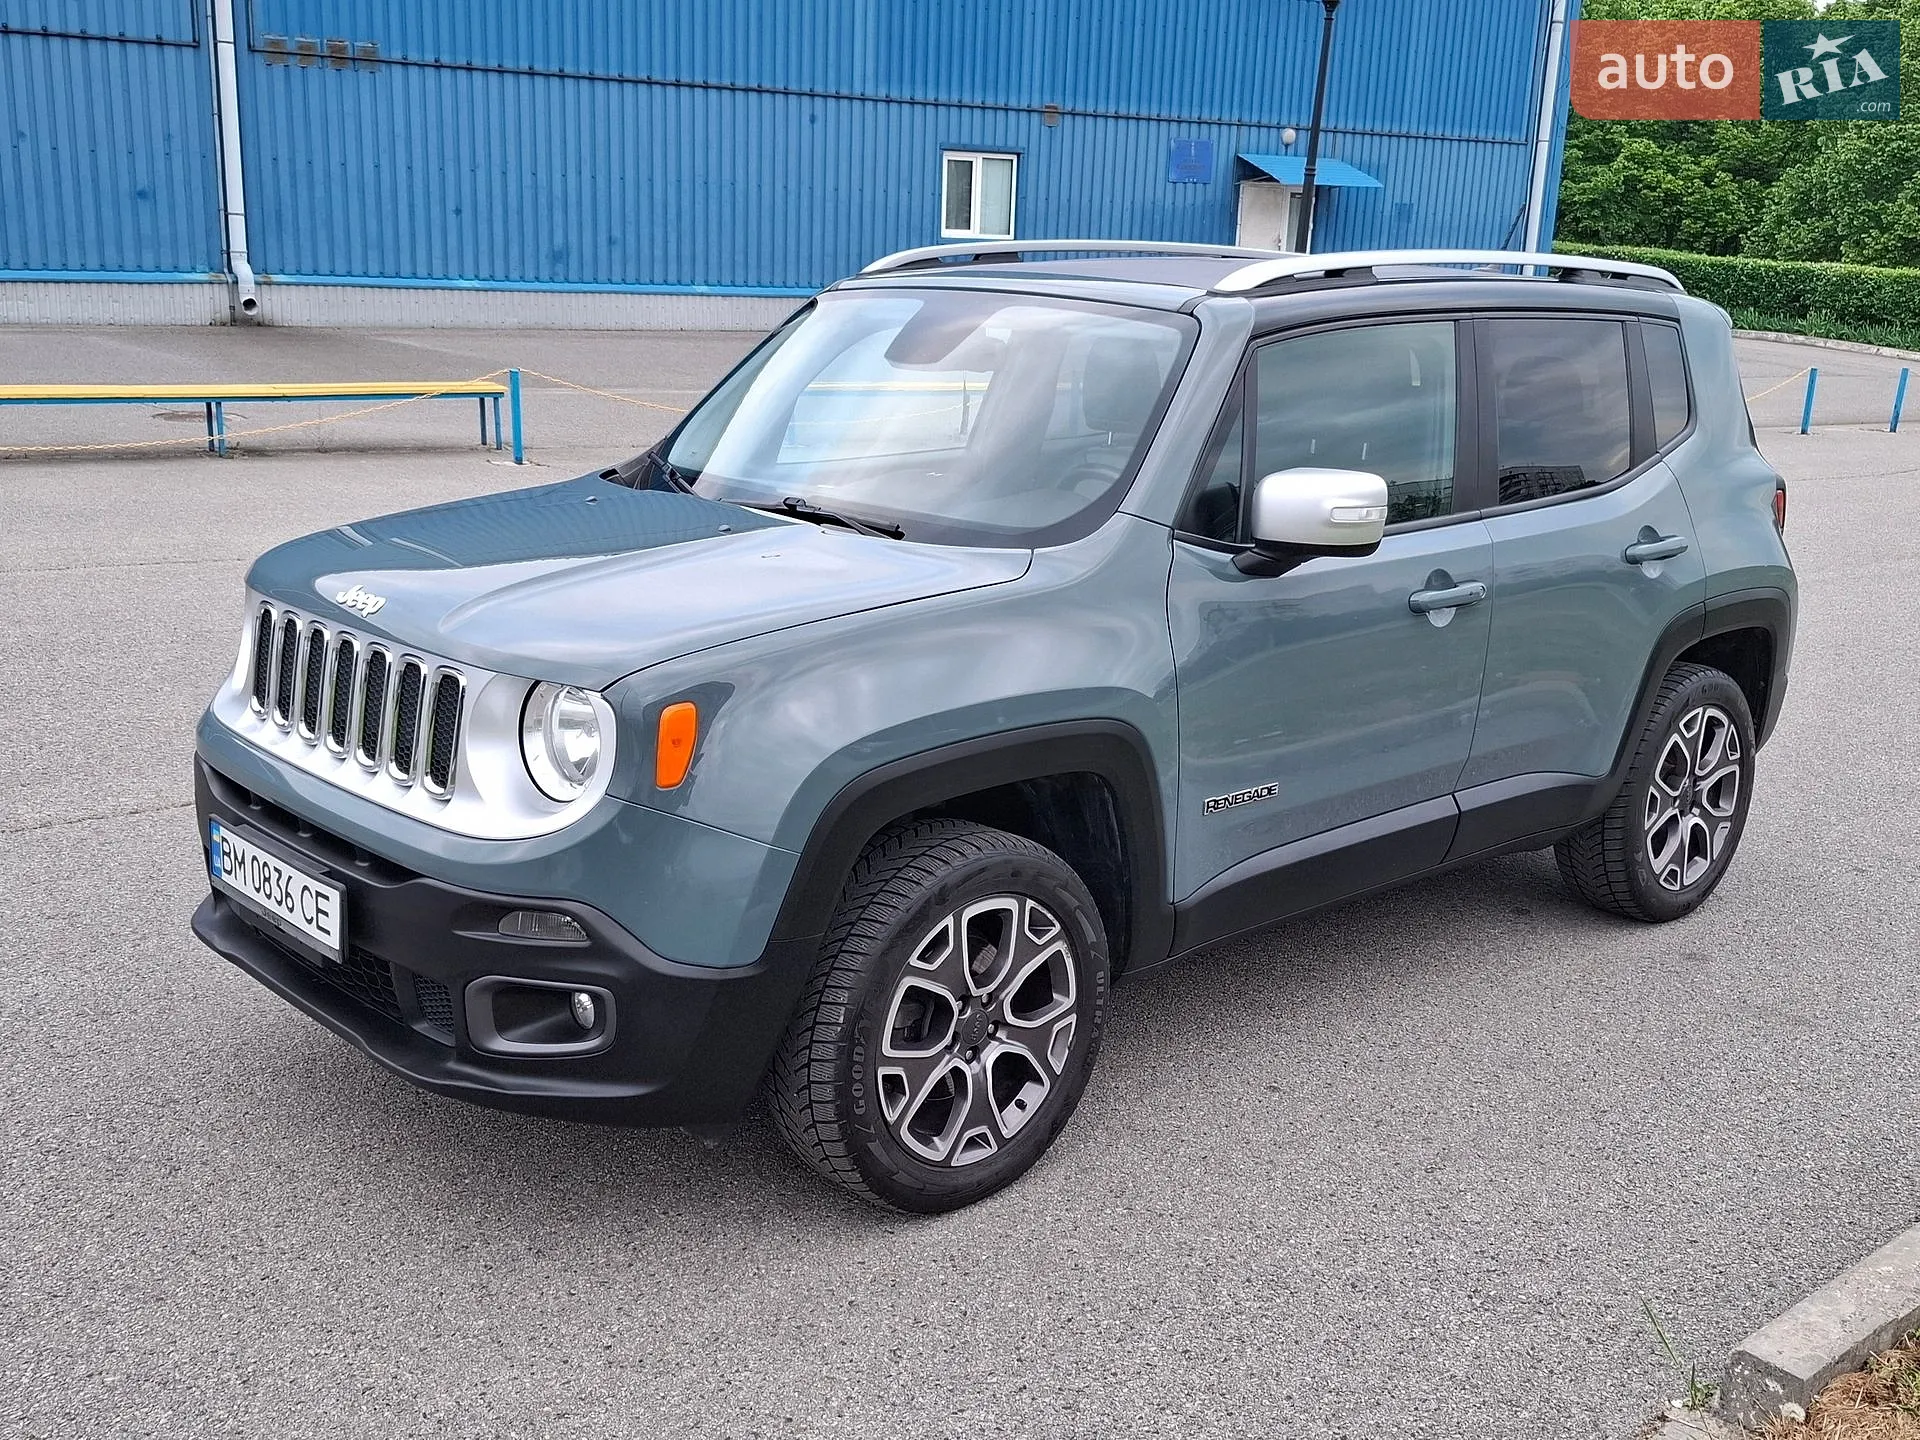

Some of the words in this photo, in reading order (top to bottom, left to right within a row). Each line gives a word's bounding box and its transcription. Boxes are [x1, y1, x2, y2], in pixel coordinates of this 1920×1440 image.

[336, 584, 387, 618] Jeep
[1203, 782, 1279, 816] RENEGADE
[221, 835, 247, 886] BM
[251, 854, 295, 914] 0836
[300, 884, 331, 937] CE
